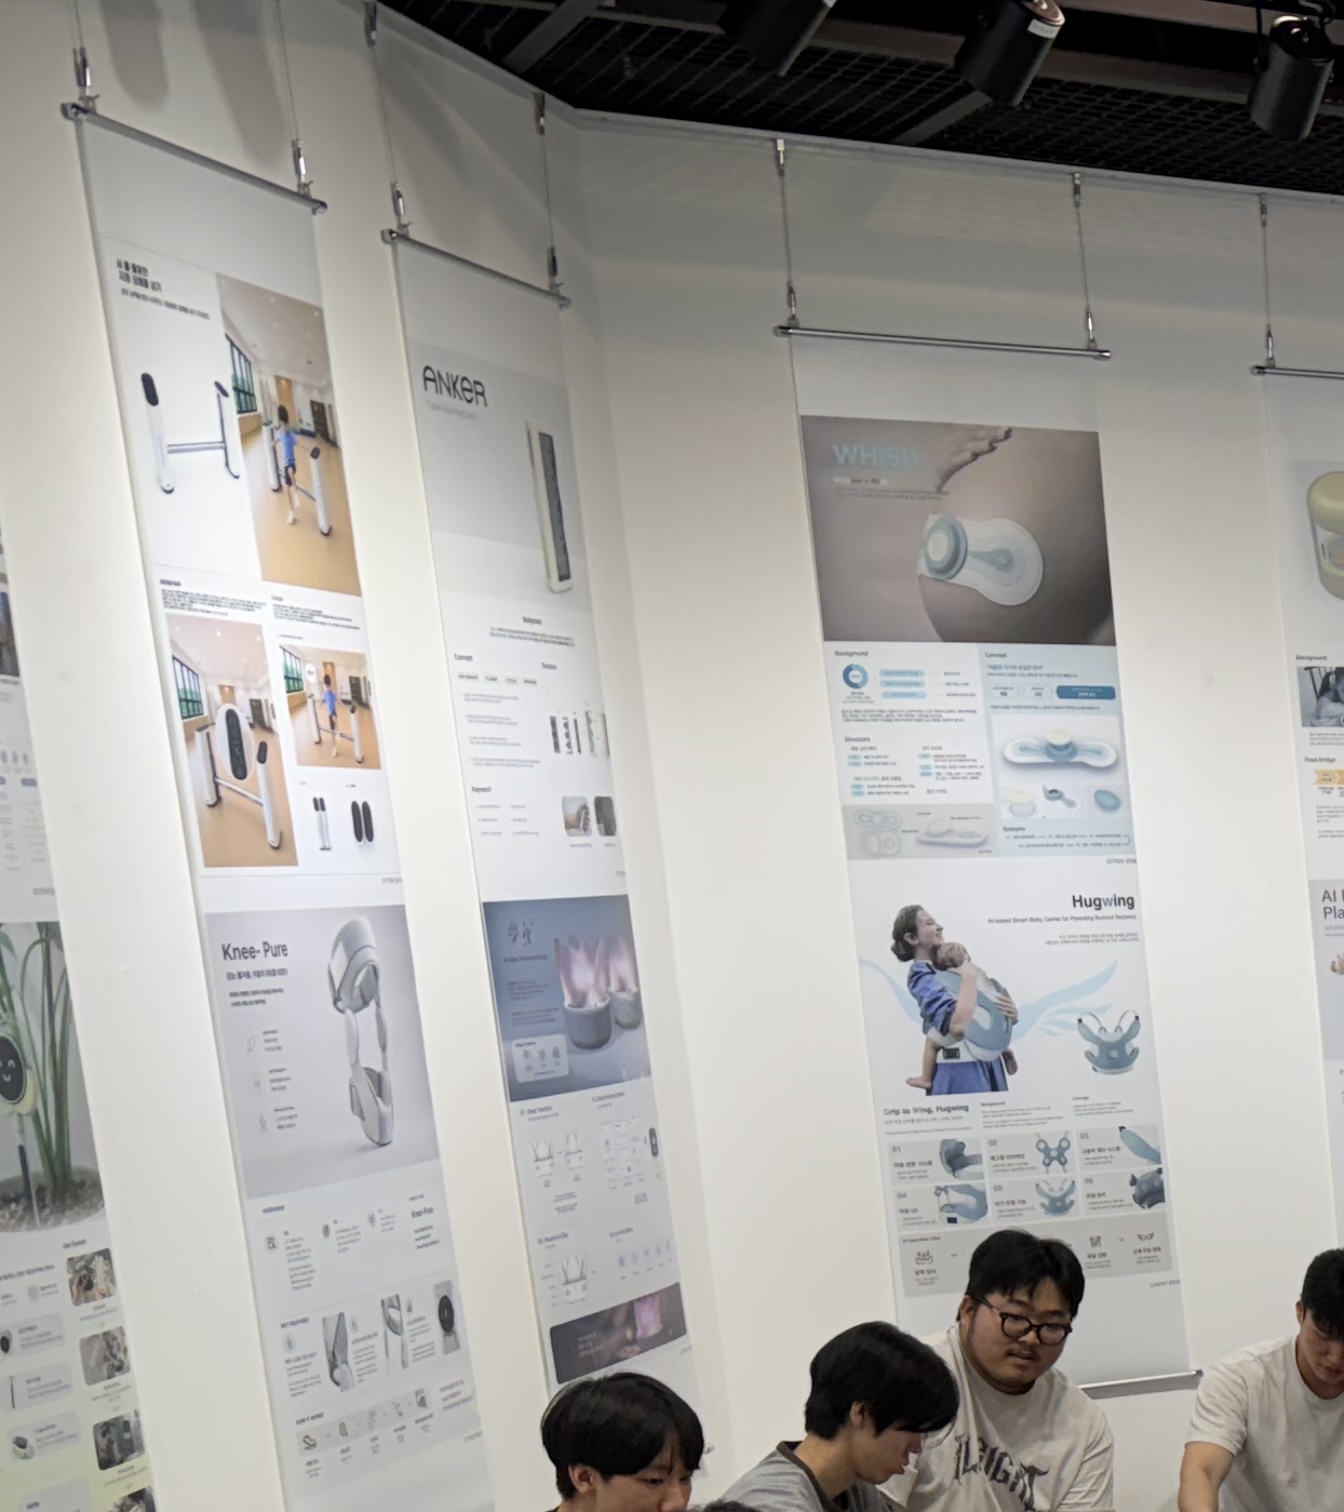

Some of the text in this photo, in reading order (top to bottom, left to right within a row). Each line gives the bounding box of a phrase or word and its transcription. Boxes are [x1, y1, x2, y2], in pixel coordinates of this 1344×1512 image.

[422, 364, 488, 408] ANKER
[1071, 893, 1136, 911] Hugwing
[1321, 889, 1337, 903] AI
[262, 940, 289, 958] Pure
